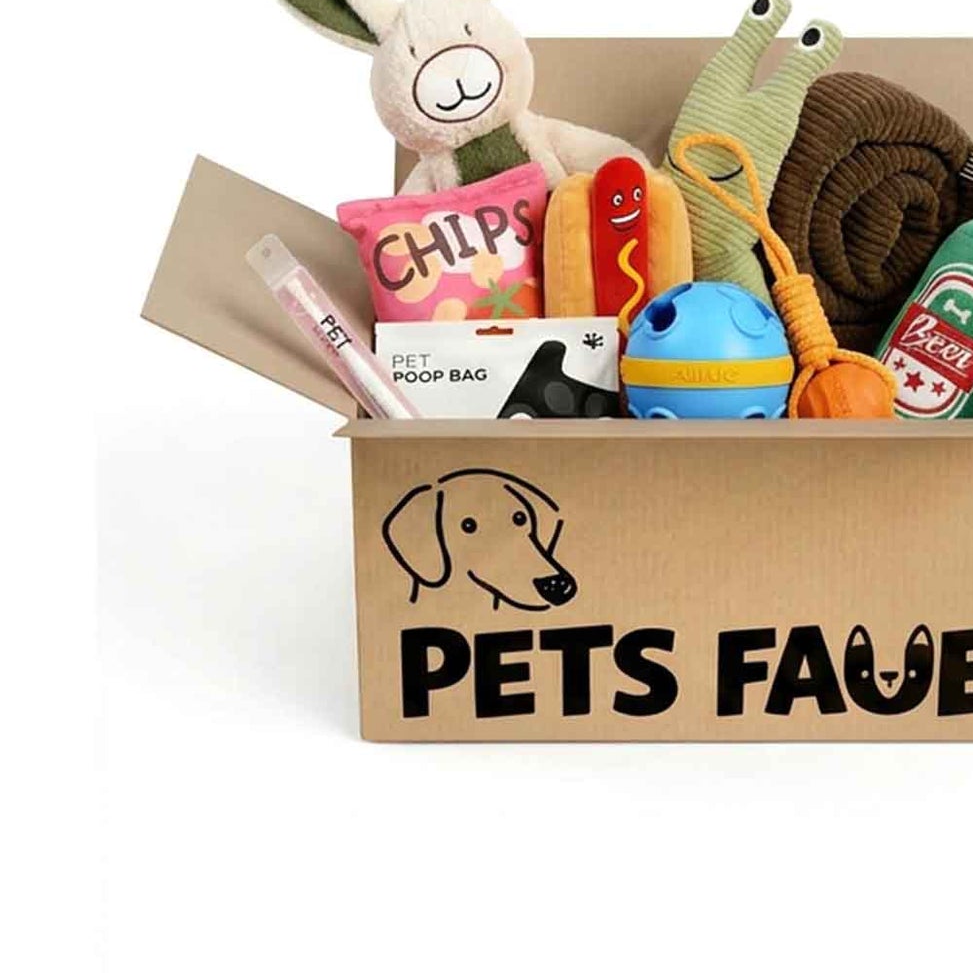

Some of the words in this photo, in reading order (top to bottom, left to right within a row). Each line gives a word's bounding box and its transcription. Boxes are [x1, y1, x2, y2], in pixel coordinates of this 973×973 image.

[373, 199, 535, 291] CHIPS
[320, 314, 353, 349] PET
[392, 354, 431, 369] PET
[393, 370, 444, 383] POOP
[449, 368, 488, 382] BAG
[401, 625, 678, 718] PETS
